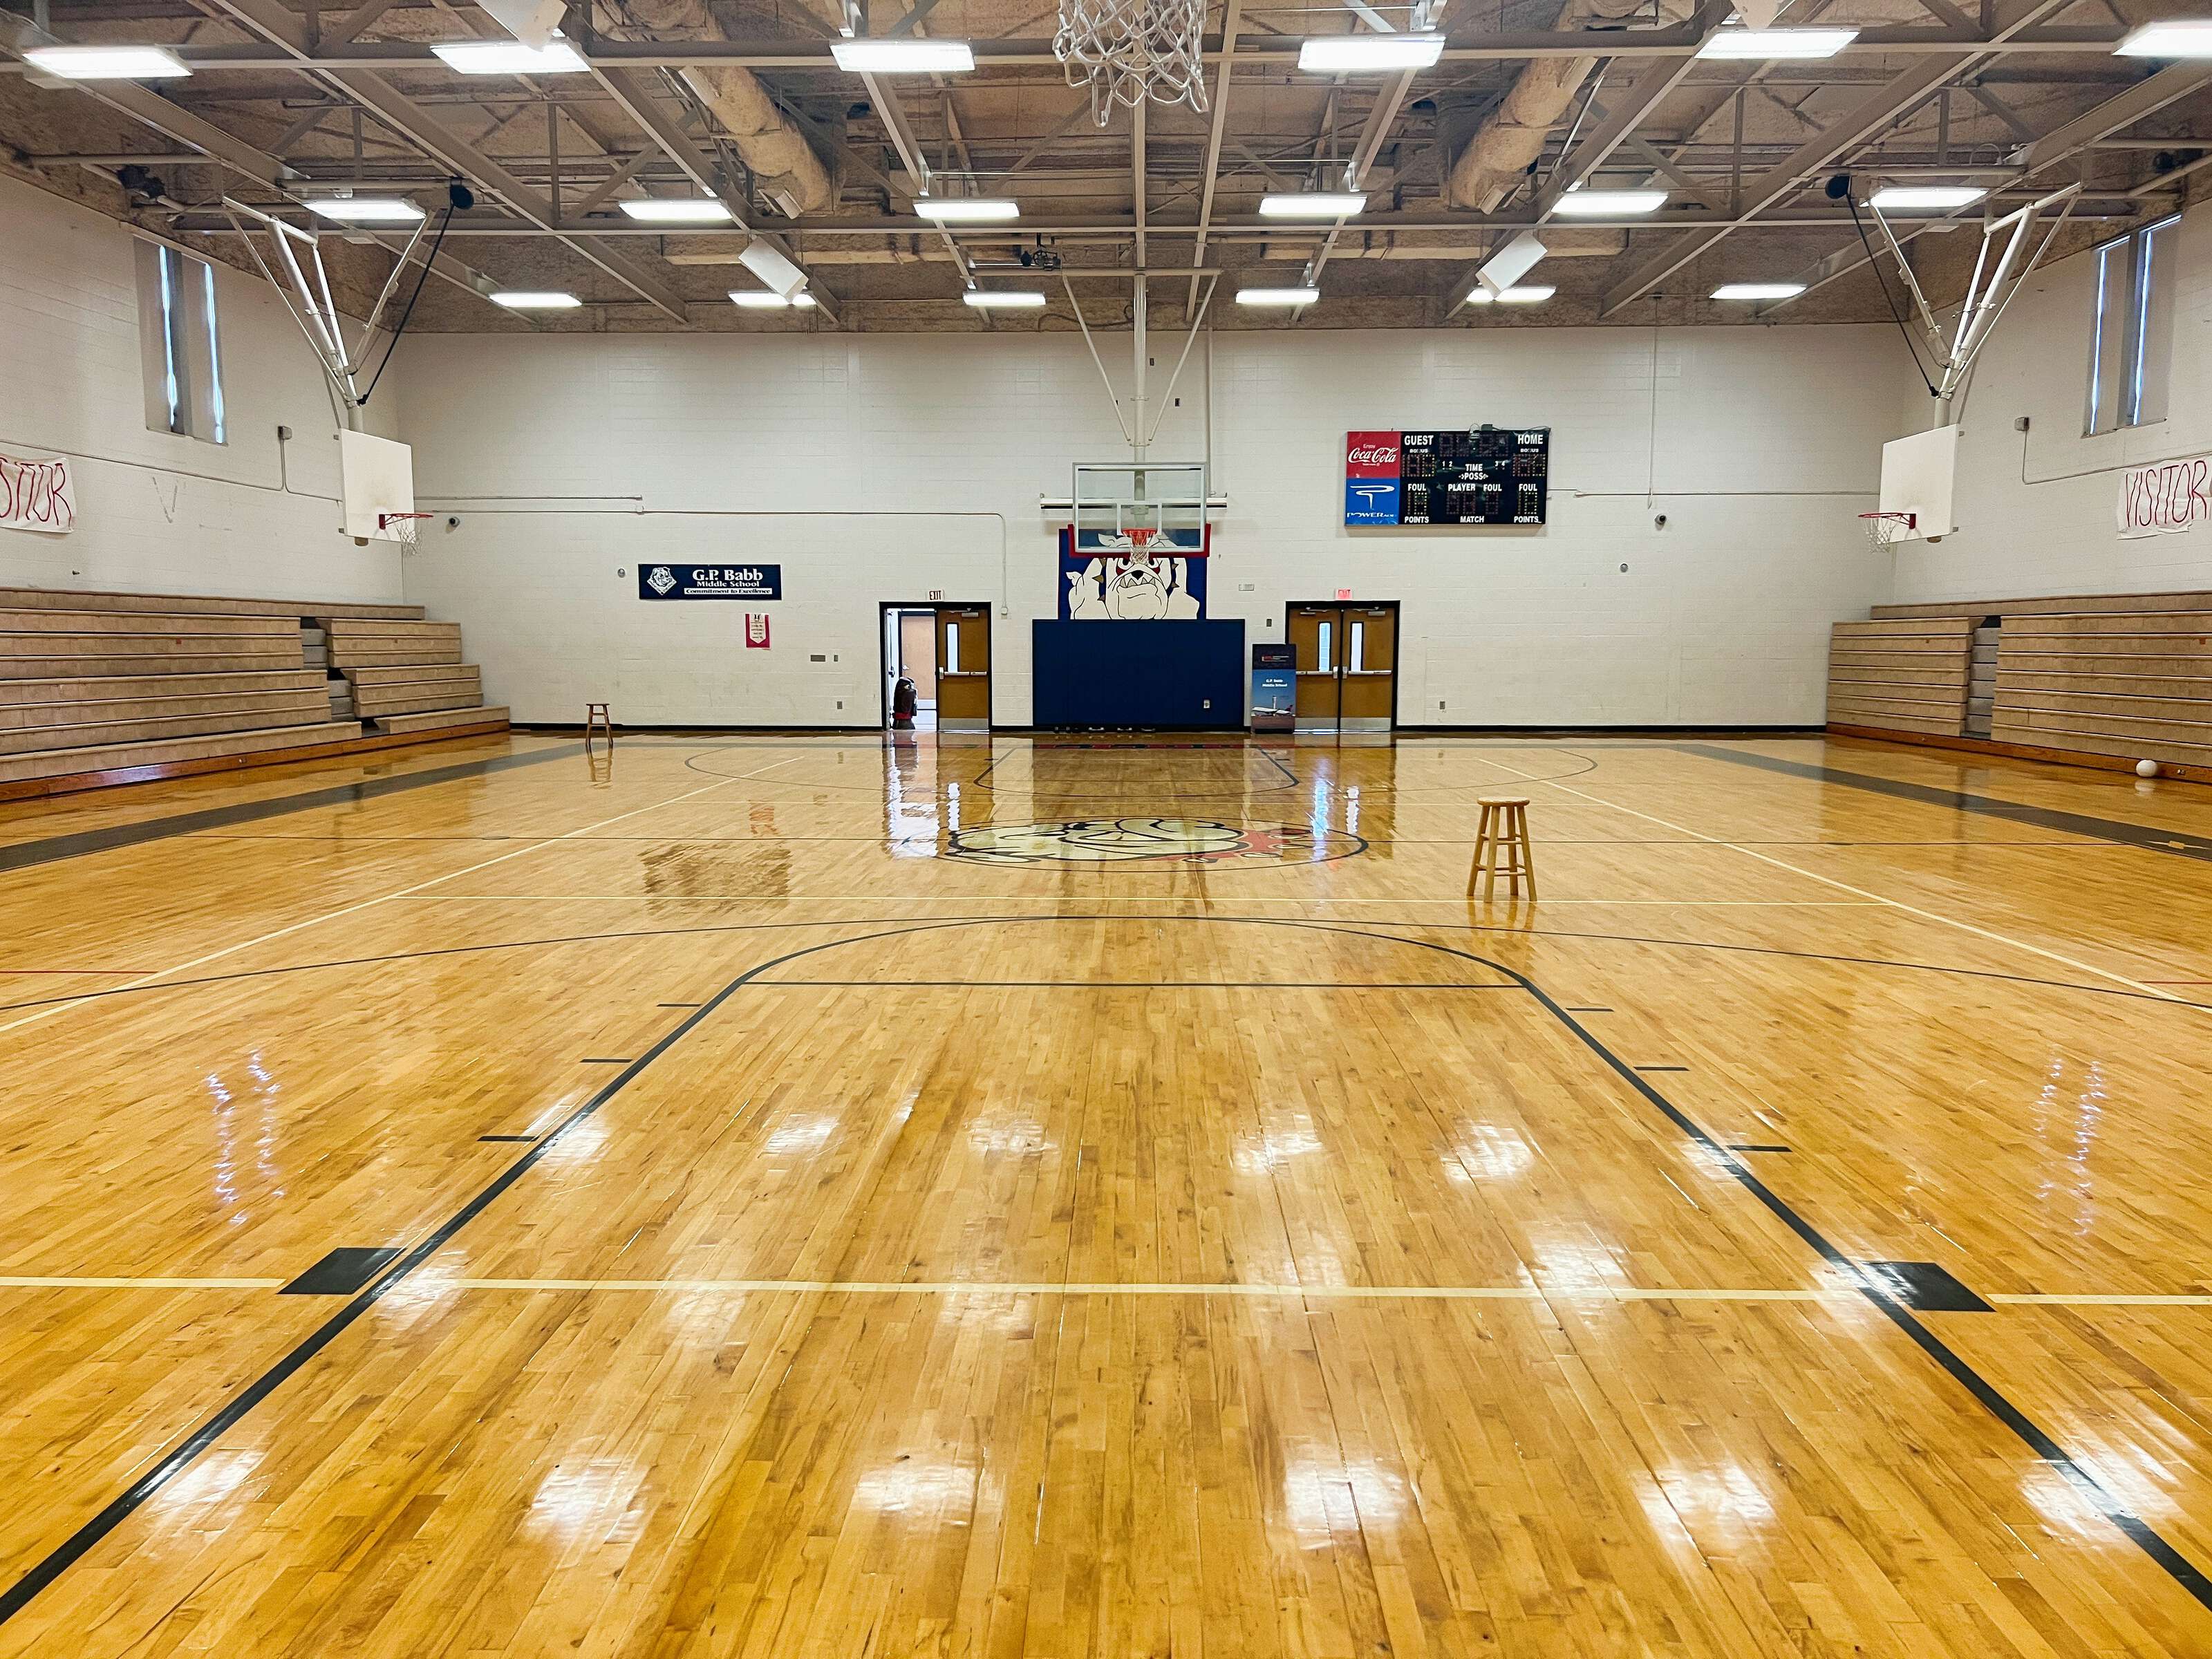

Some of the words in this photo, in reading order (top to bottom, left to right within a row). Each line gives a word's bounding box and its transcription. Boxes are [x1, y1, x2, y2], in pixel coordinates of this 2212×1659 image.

[1404, 435, 1434, 446] GUEST
[1517, 434, 1544, 444] HOME
[1348, 447, 1399, 463] Coca-Cola
[1465, 463, 1483, 471] TIME
[1407, 483, 1427, 491] FOUL
[1447, 483, 1476, 491] PLAYER
[1483, 483, 1503, 491] FOUL
[1519, 483, 1538, 491] FOUL
[2126, 460, 2207, 527] VISITOR
[692, 569, 719, 581] G.P.
[724, 568, 763, 581] Babb
